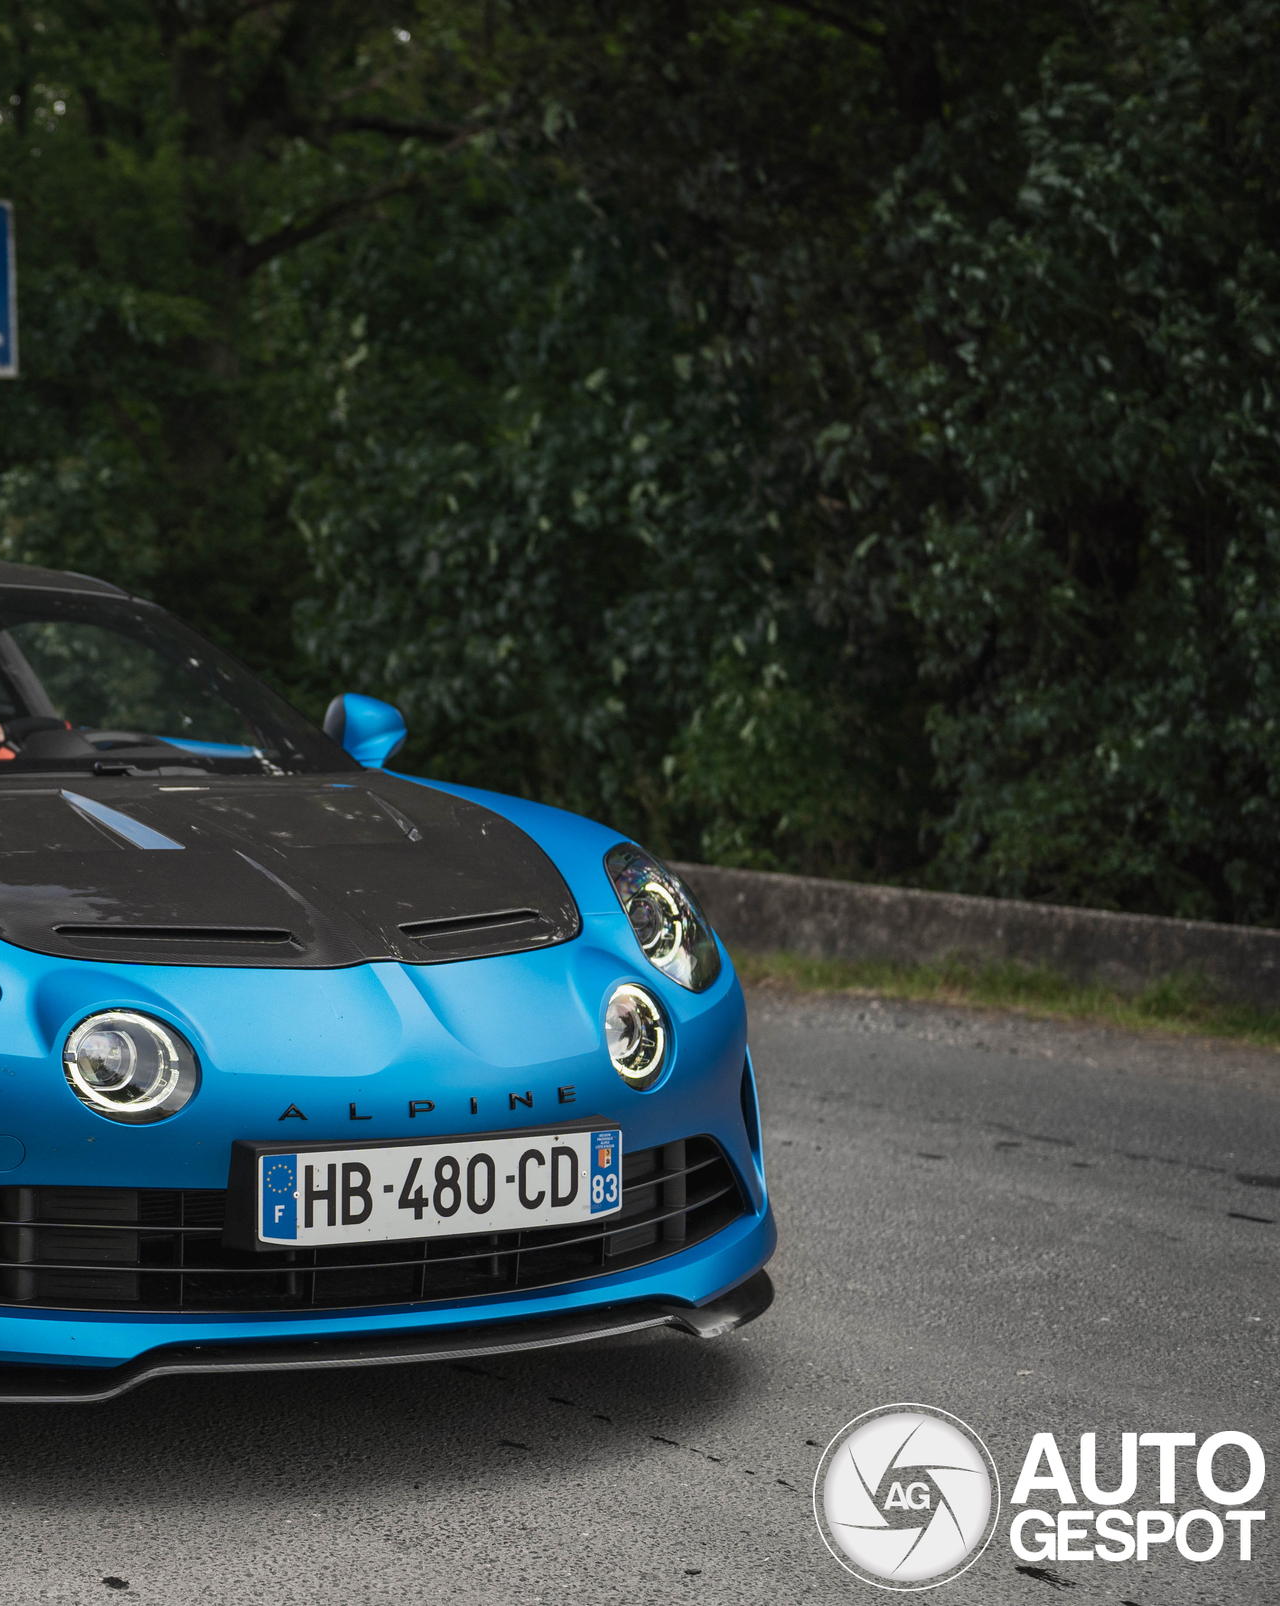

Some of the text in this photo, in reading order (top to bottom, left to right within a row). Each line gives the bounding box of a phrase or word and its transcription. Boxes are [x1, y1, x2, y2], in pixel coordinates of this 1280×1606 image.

[278, 1084, 577, 1121] ALPINE
[304, 1145, 579, 1228] HB-480-CD
[592, 1173, 618, 1204] 83
[274, 1204, 285, 1223] F
